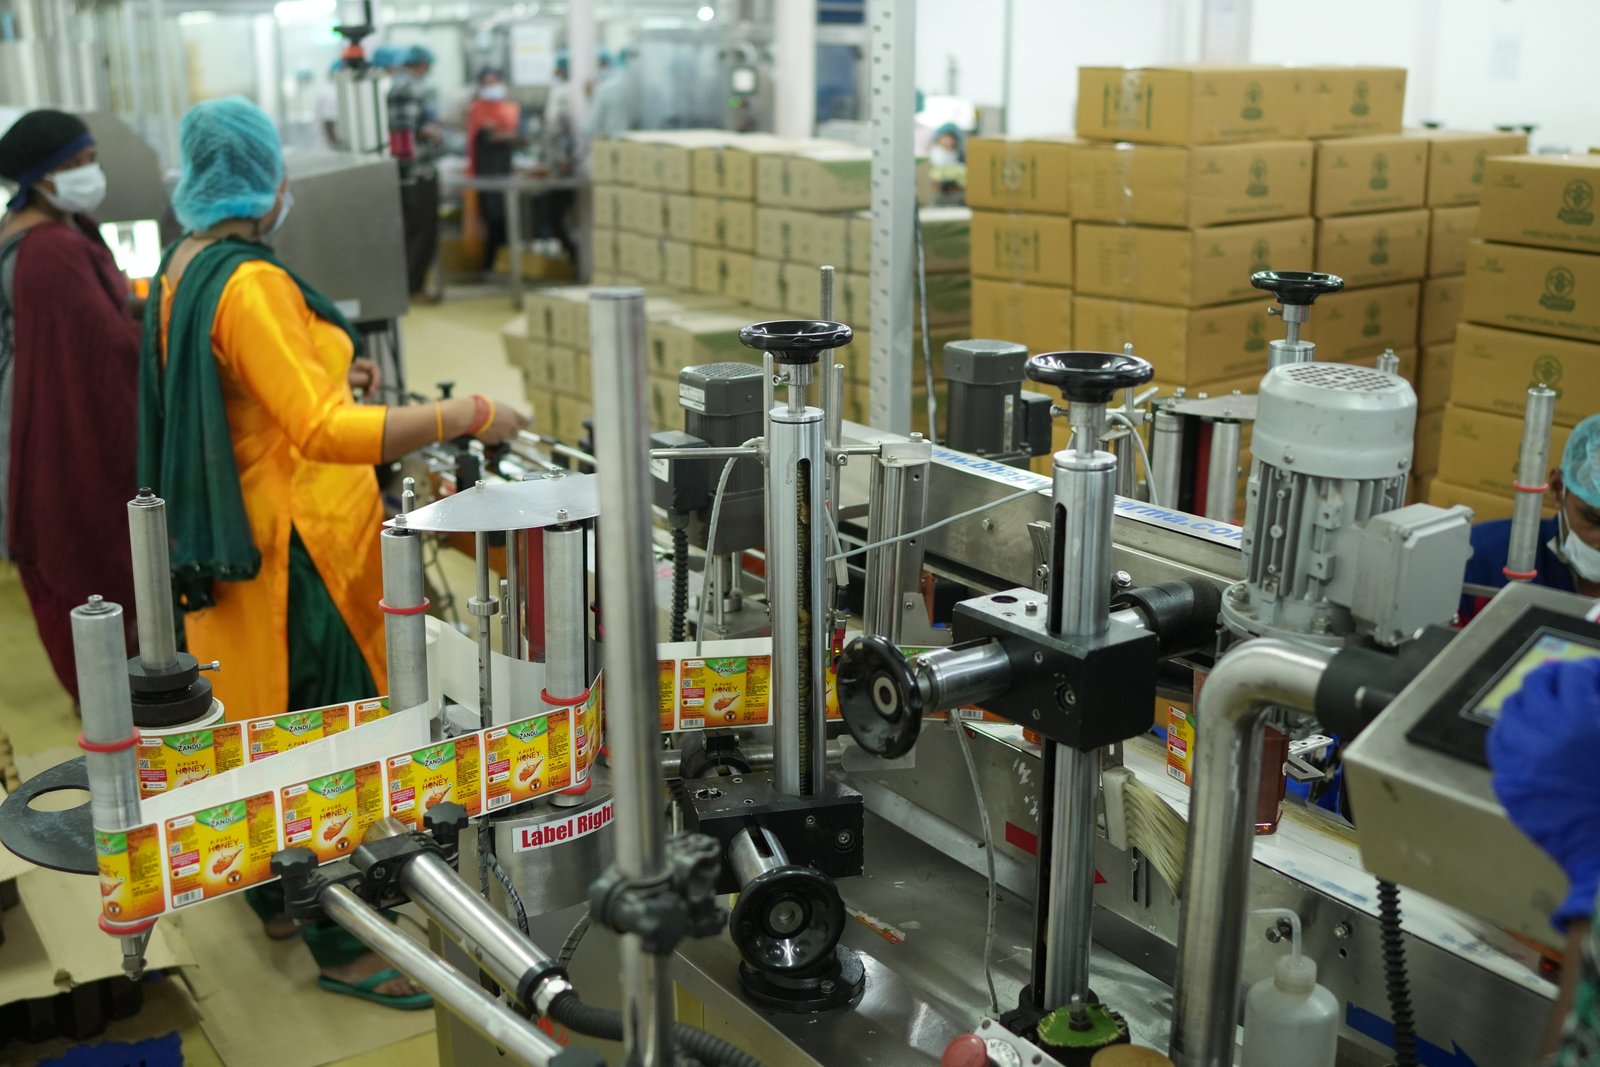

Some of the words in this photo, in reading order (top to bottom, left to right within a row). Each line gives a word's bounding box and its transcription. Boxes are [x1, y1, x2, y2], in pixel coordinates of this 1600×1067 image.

[288, 724, 312, 733] ZANDU
[519, 729, 538, 740] ZANDU
[177, 743, 202, 752] ZANDU
[424, 756, 445, 767] ZANDU
[516, 750, 541, 763] HONEY
[175, 763, 206, 776] HONEY
[422, 777, 449, 791] HONEY
[322, 786, 344, 796] ZANDU
[320, 807, 348, 821] HONEY
[210, 816, 235, 828] ZANDU
[521, 819, 573, 848] Label
[208, 839, 239, 854] HONEY
